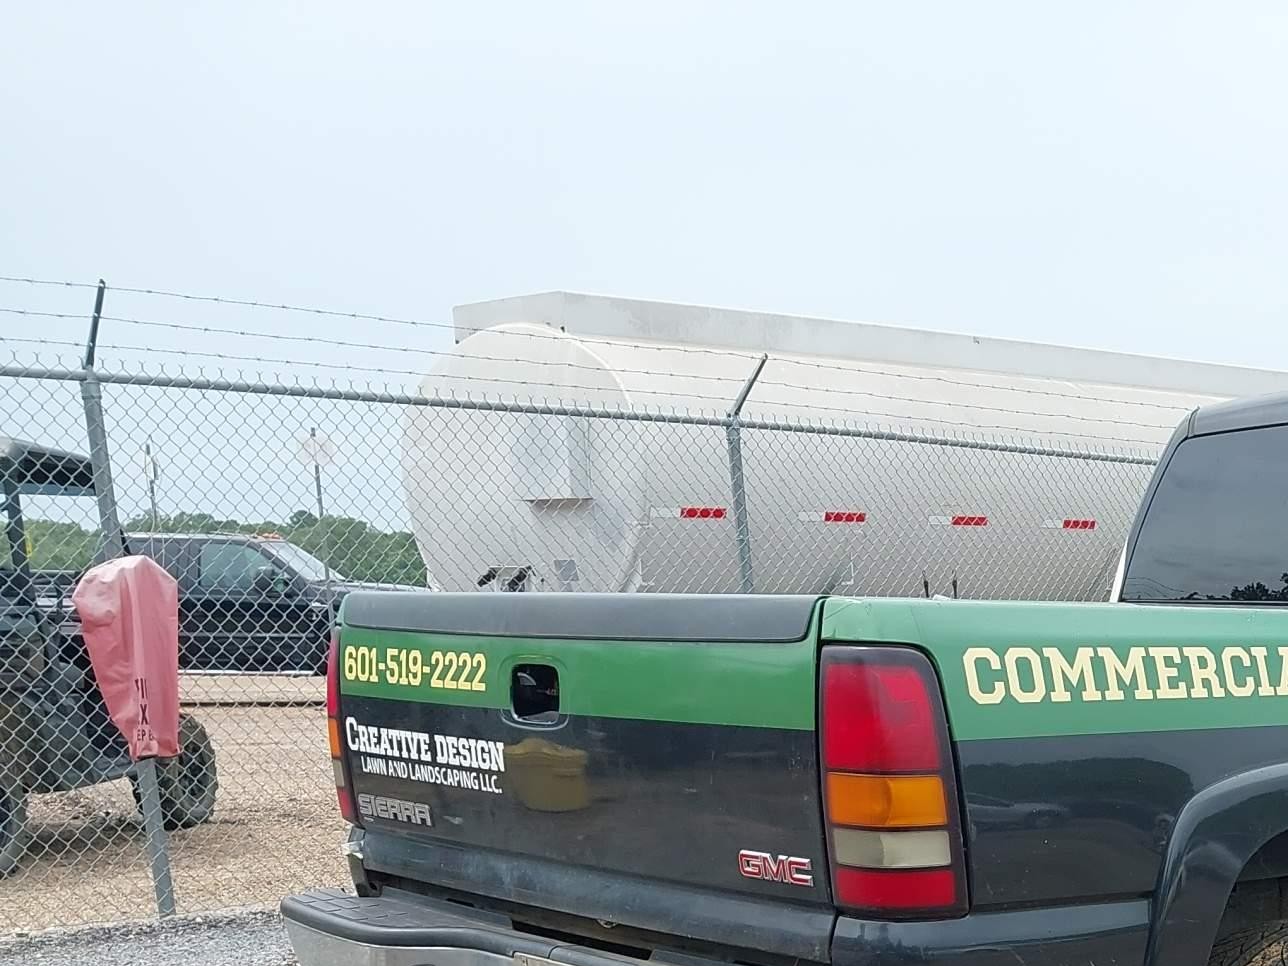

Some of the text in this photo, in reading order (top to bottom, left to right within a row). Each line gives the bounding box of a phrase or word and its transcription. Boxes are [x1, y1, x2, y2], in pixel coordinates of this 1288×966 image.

[343, 645, 487, 692] 601-519-2222
[345, 716, 505, 772] CREATIVE DESIGN
[361, 755, 503, 794] LAWN AND LANDSCAPING LLC.
[358, 793, 433, 827] SIERRA
[739, 849, 814, 888] GMC
